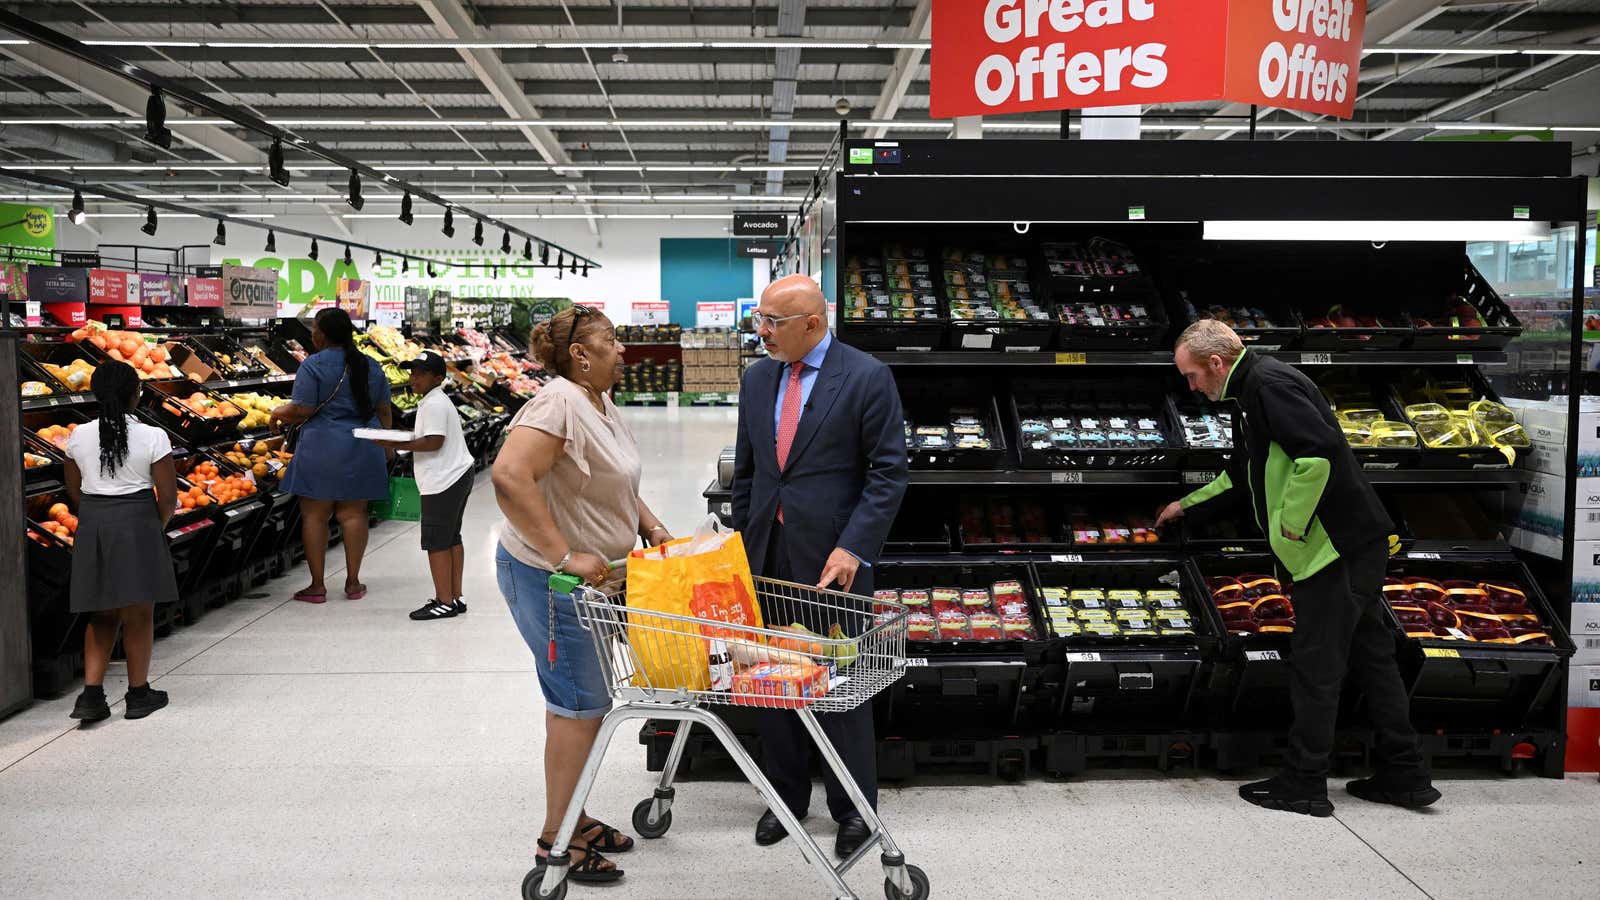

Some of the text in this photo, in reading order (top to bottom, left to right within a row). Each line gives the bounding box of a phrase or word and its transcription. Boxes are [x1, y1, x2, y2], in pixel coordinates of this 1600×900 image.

[984, 0, 1155, 43] Great
[1273, 0, 1353, 42] Great
[974, 42, 1168, 107] Offers
[1258, 41, 1349, 103] Offers
[743, 221, 779, 229] Avocados
[223, 257, 362, 304] SDA
[374, 257, 534, 279] SAVING
[90, 277, 105, 287] Meal
[91, 287, 105, 297] Deal
[230, 279, 273, 305] Organic
[1537, 429, 1552, 438] AQUA
